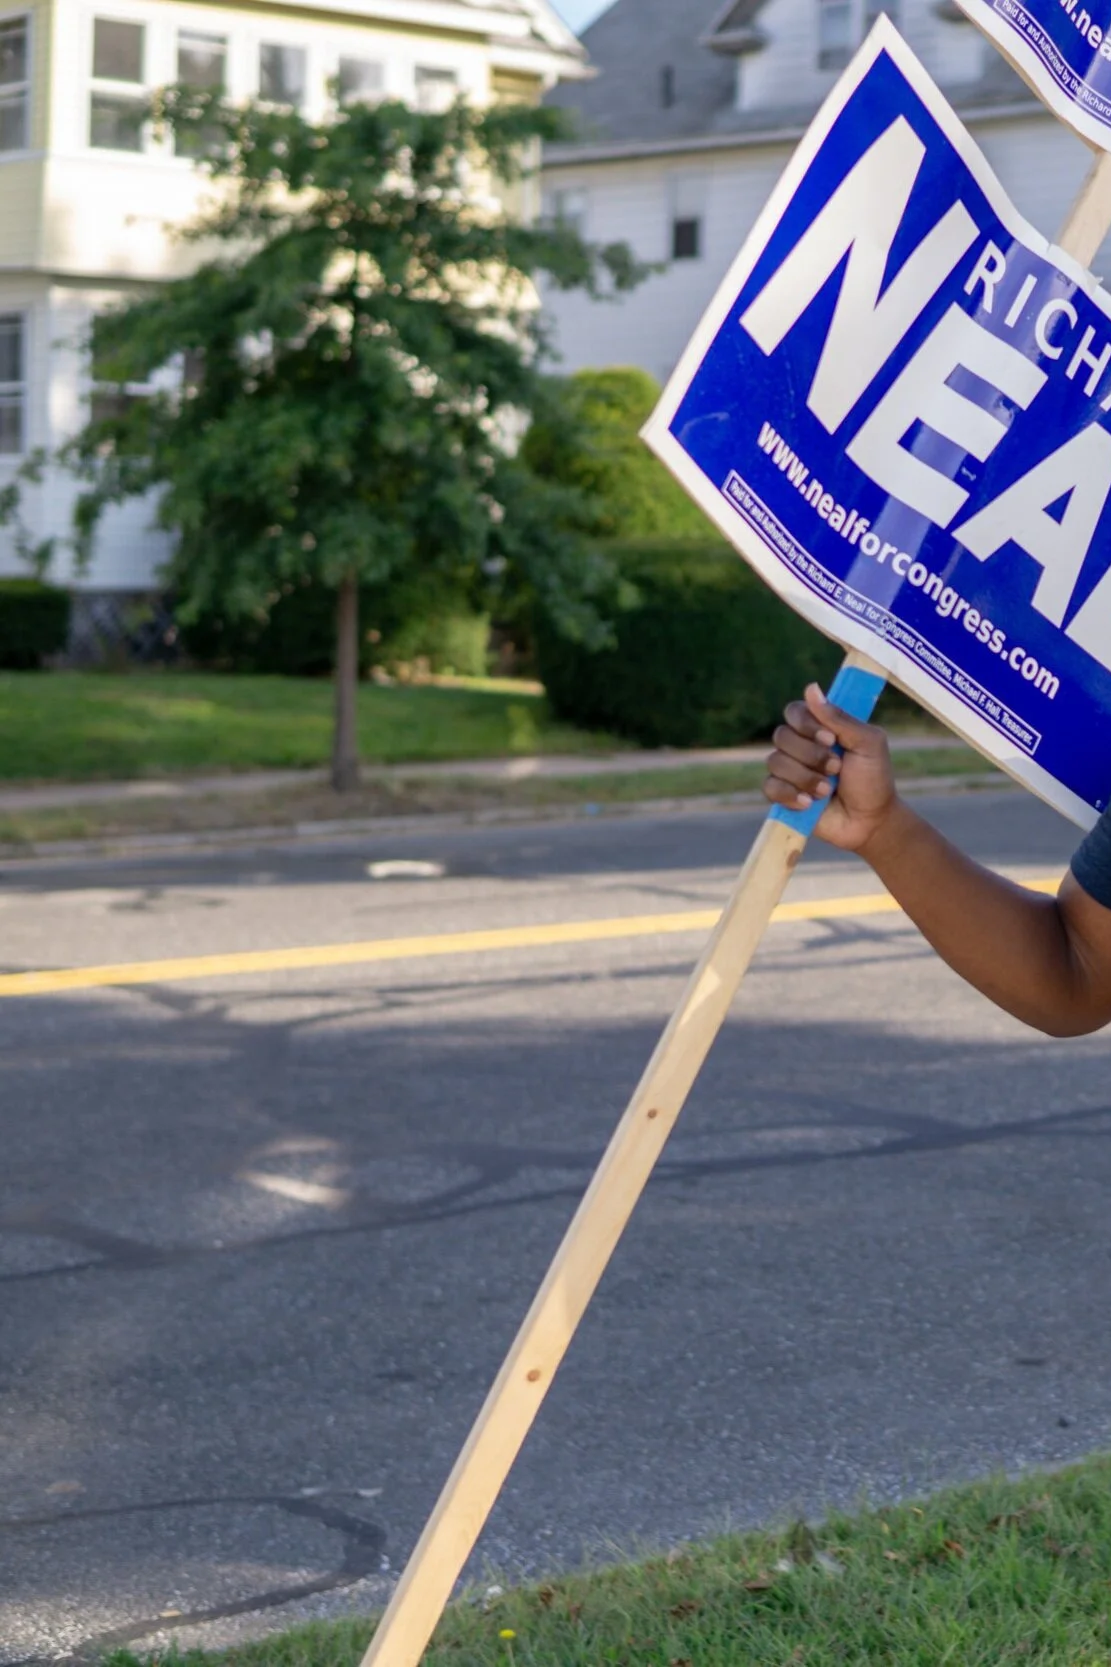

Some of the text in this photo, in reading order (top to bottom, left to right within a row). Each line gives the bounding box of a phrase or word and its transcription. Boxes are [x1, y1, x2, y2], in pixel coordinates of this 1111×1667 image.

[1002, 0, 1020, 18] Paid
[1018, 12, 1030, 28] for
[1026, 24, 1041, 42] and
[1038, 36, 1065, 76] Authorized
[1062, 68, 1072, 85] by
[1069, 78, 1083, 96] the
[750, 504, 766, 521] and
[787, 545, 799, 562] by
[795, 554, 809, 571] the
[807, 563, 837, 594] Richard
[844, 593, 867, 614] Neal
[865, 606, 880, 621] for
[881, 616, 916, 648] Congress
[952, 672, 981, 702] Michael
[757, 420, 1059, 700] www.nealforcongress.com
